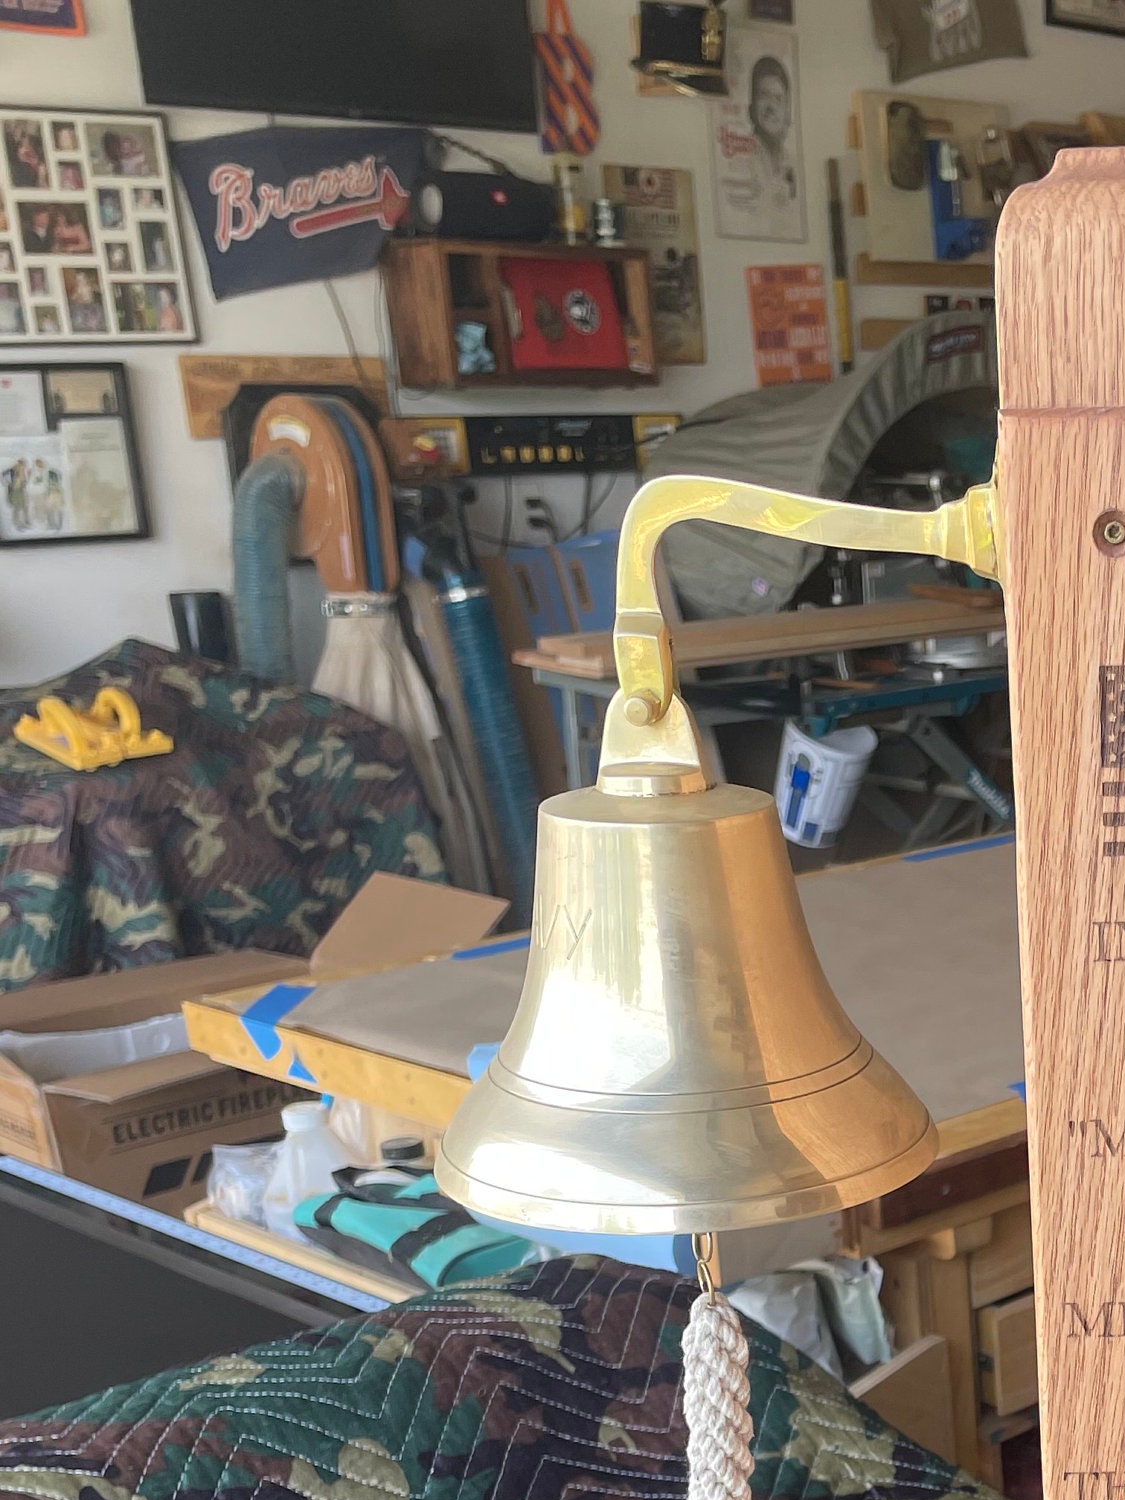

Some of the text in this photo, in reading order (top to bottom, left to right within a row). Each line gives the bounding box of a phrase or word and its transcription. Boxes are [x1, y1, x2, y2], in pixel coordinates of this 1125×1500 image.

[209, 156, 378, 252] Braves
[112, 1083, 315, 1144] ELECTRIC FIREPL
